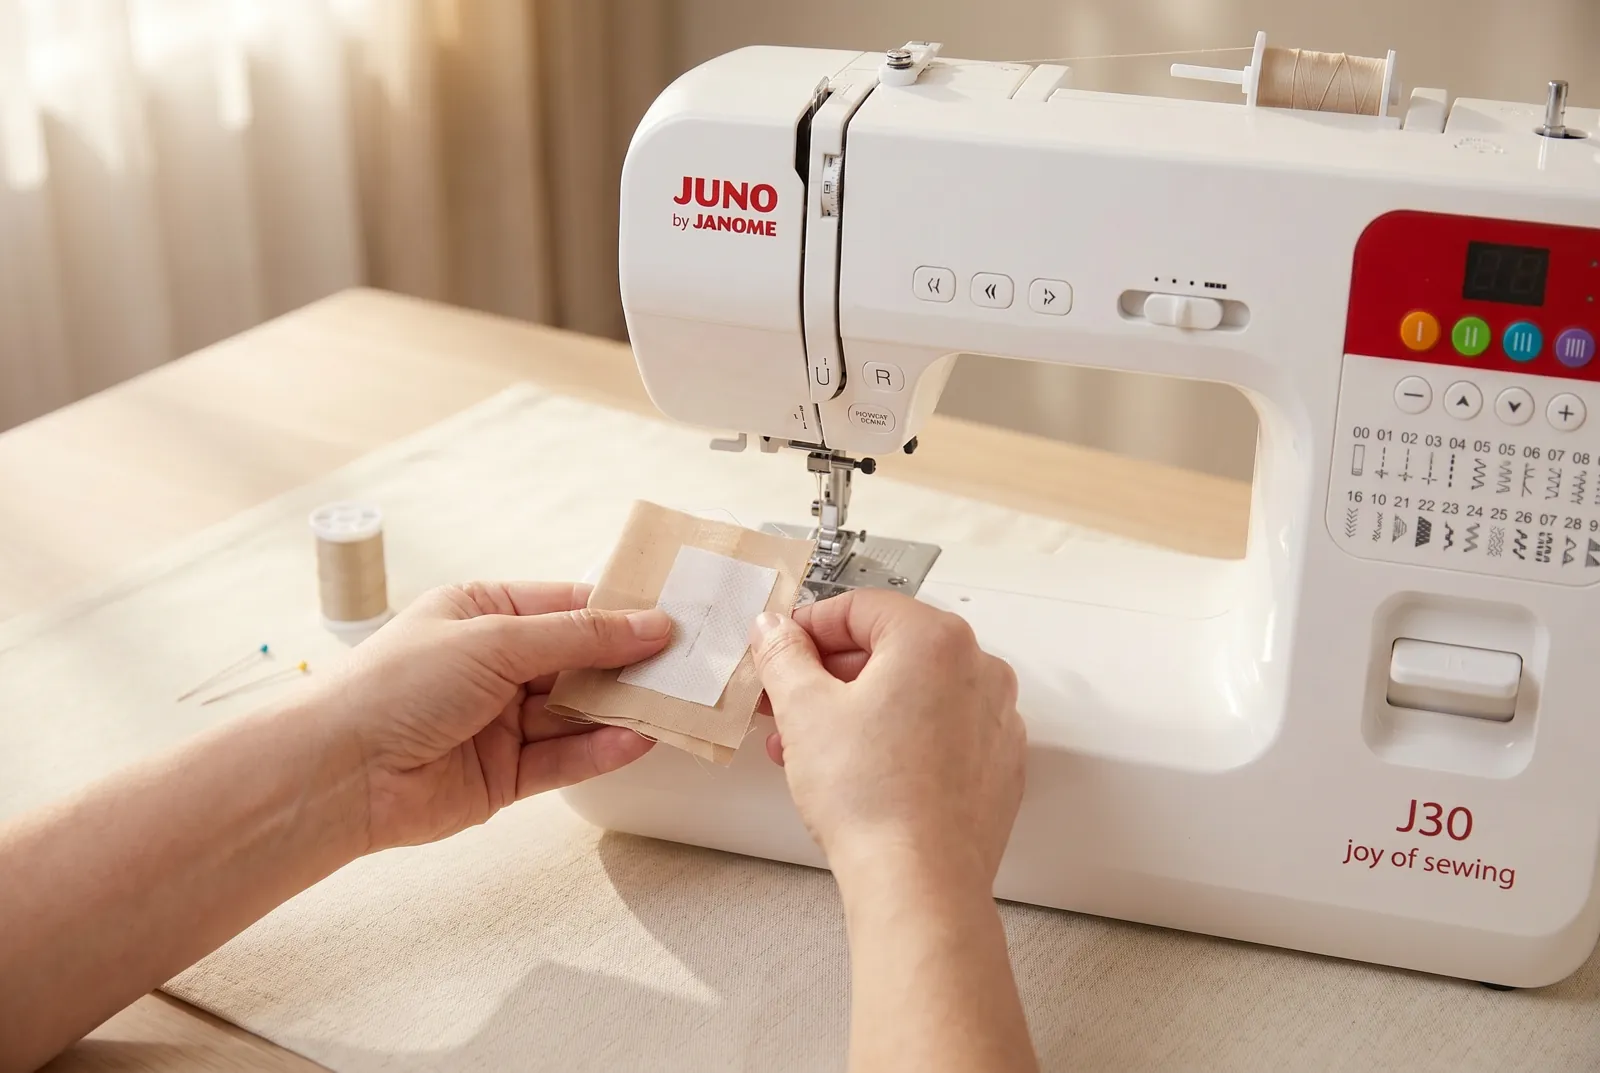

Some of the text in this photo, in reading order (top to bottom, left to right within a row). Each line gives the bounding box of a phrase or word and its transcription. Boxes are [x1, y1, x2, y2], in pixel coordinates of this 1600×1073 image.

[673, 176, 778, 213] JUNO
[672, 213, 777, 237] by JANOME
[875, 368, 891, 386] R
[1353, 426, 1370, 439] 00
[1377, 429, 1393, 441] 01
[1401, 432, 1418, 444] 02
[1425, 434, 1442, 447] 03
[1449, 437, 1466, 450] 04
[1473, 440, 1491, 453] 05
[1498, 443, 1516, 456] 05
[1523, 446, 1541, 459] 06
[1548, 449, 1565, 461] 07
[1572, 452, 1590, 465] 08
[1347, 490, 1363, 503] 16
[1371, 493, 1386, 505] 10
[1394, 496, 1409, 508] 21
[1418, 499, 1435, 512] 22
[1442, 502, 1459, 514] 23
[1466, 505, 1483, 517] 24
[1490, 508, 1508, 520] 25
[1515, 511, 1532, 524] 26
[1540, 514, 1558, 526] 07
[1564, 517, 1582, 530] 28
[1396, 799, 1473, 841] J30
[1342, 839, 1515, 890] joy of sewing
